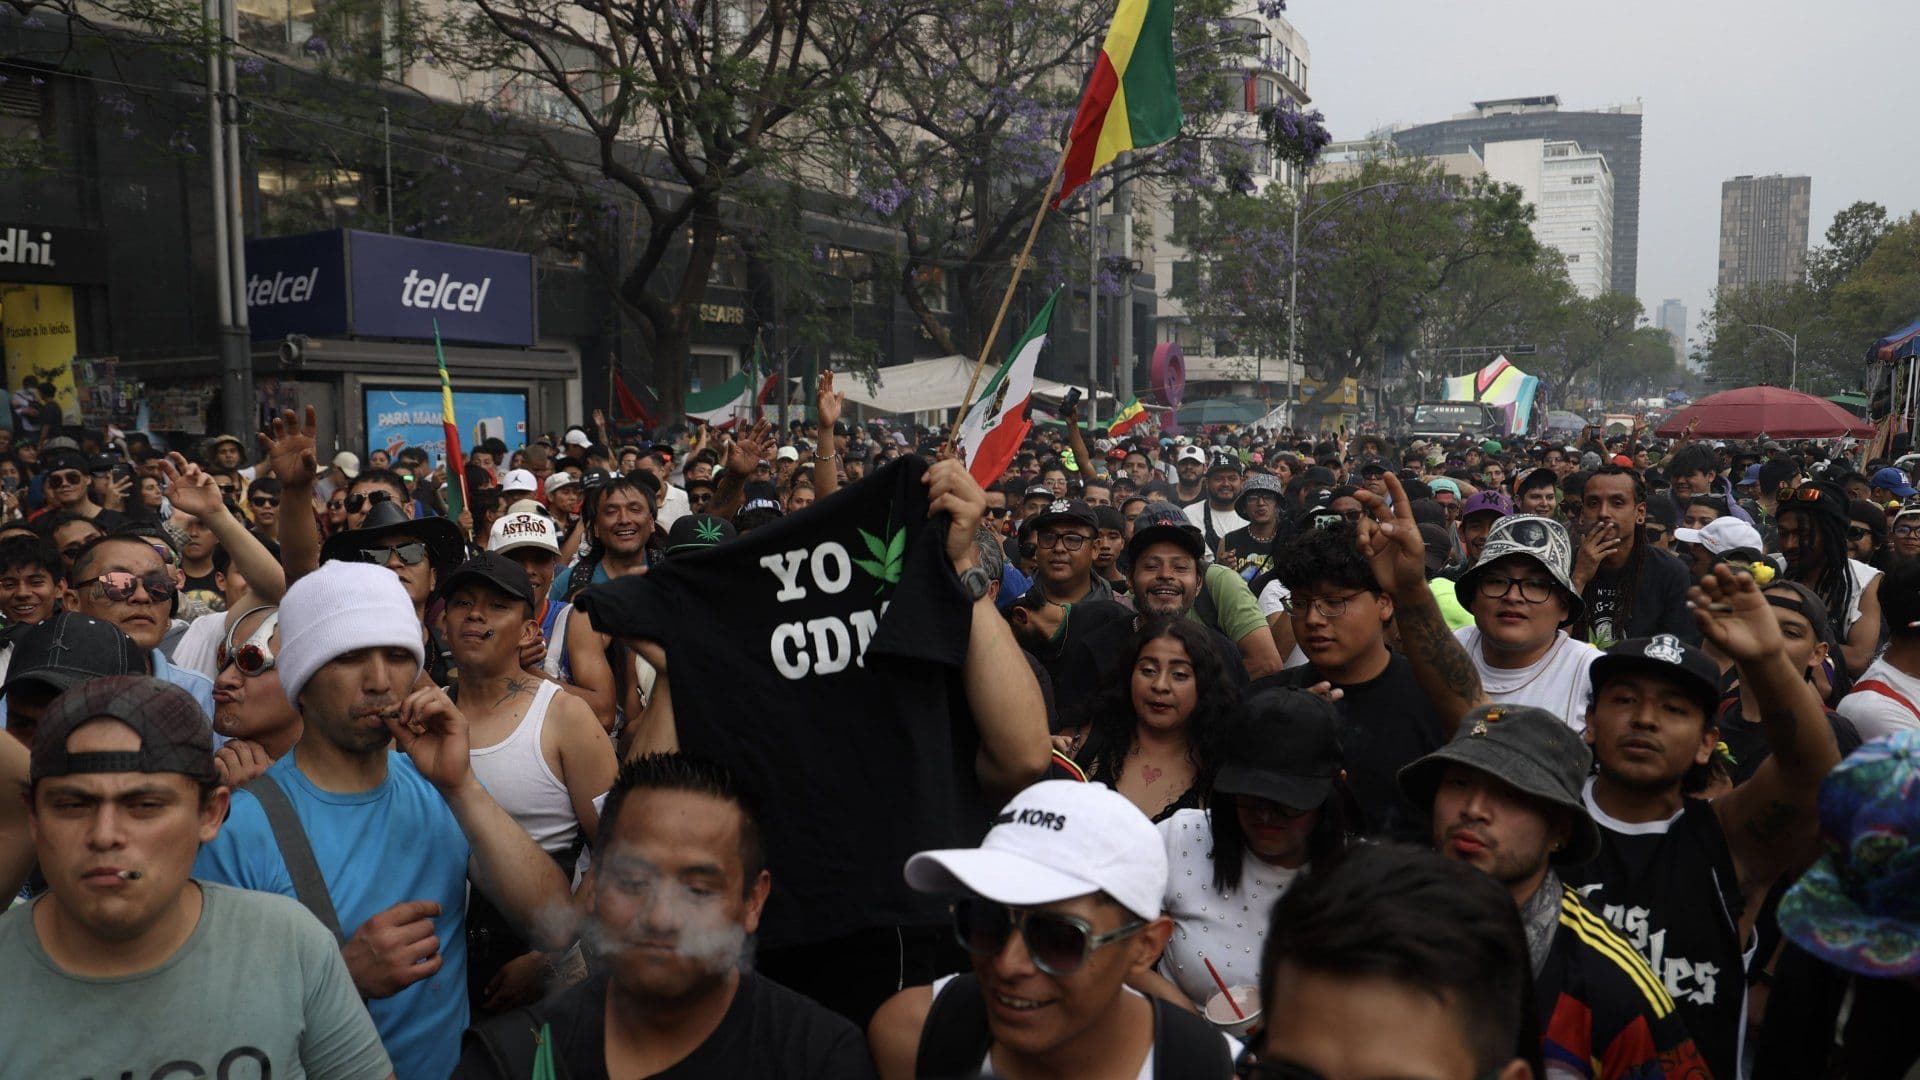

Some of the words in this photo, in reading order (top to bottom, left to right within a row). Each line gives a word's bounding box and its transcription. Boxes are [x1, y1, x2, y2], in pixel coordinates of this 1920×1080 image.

[246, 267, 319, 307] telcel
[401, 269, 491, 312] telcel
[700, 303, 744, 324] SEARS
[378, 411, 410, 427] PARA
[412, 410, 444, 426] MAM
[502, 519, 546, 536] ASTROS
[760, 541, 852, 602] YO
[771, 601, 891, 680] CDM
[1017, 808, 1066, 831] KORS
